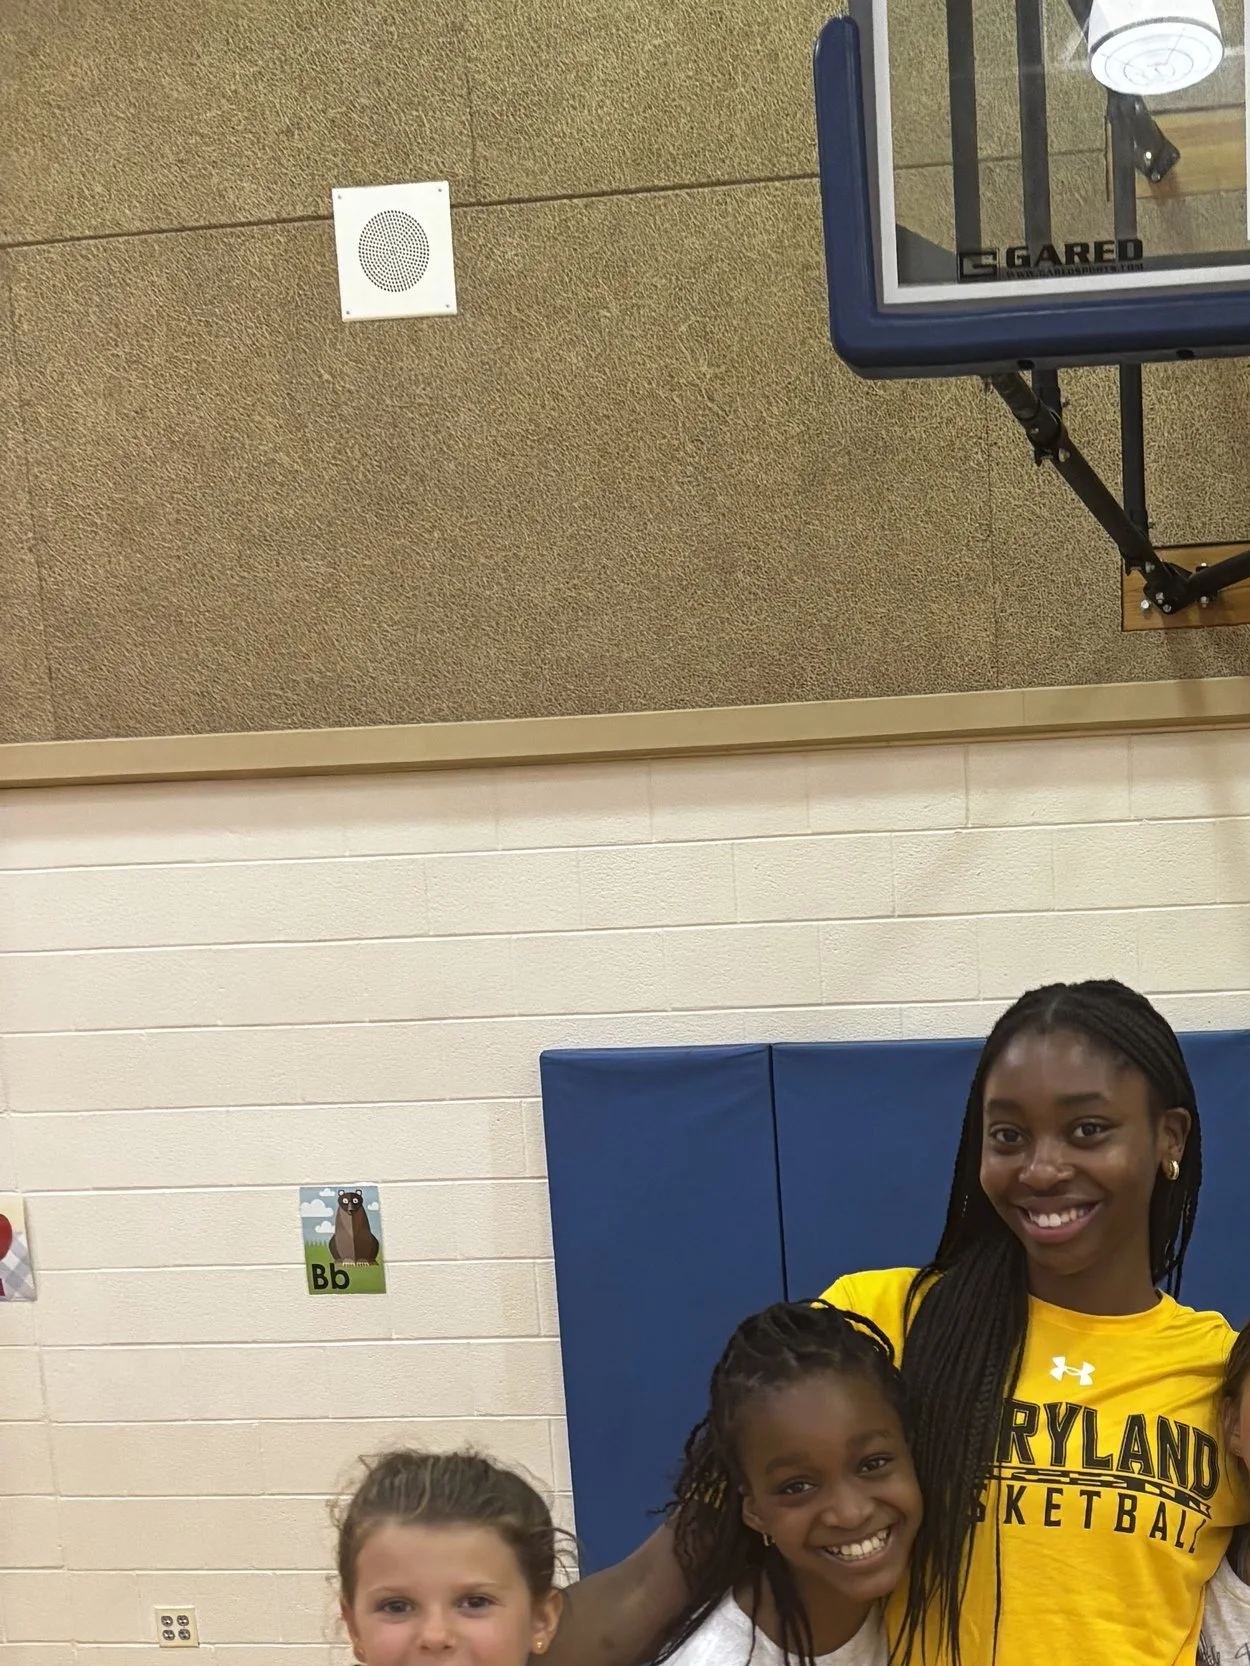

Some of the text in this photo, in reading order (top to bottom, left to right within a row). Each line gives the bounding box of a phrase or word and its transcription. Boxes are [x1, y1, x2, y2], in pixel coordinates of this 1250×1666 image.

[1005, 238, 1144, 269] GARED
[311, 1262, 351, 1290] Bb
[997, 1397, 1220, 1501] RYLAND
